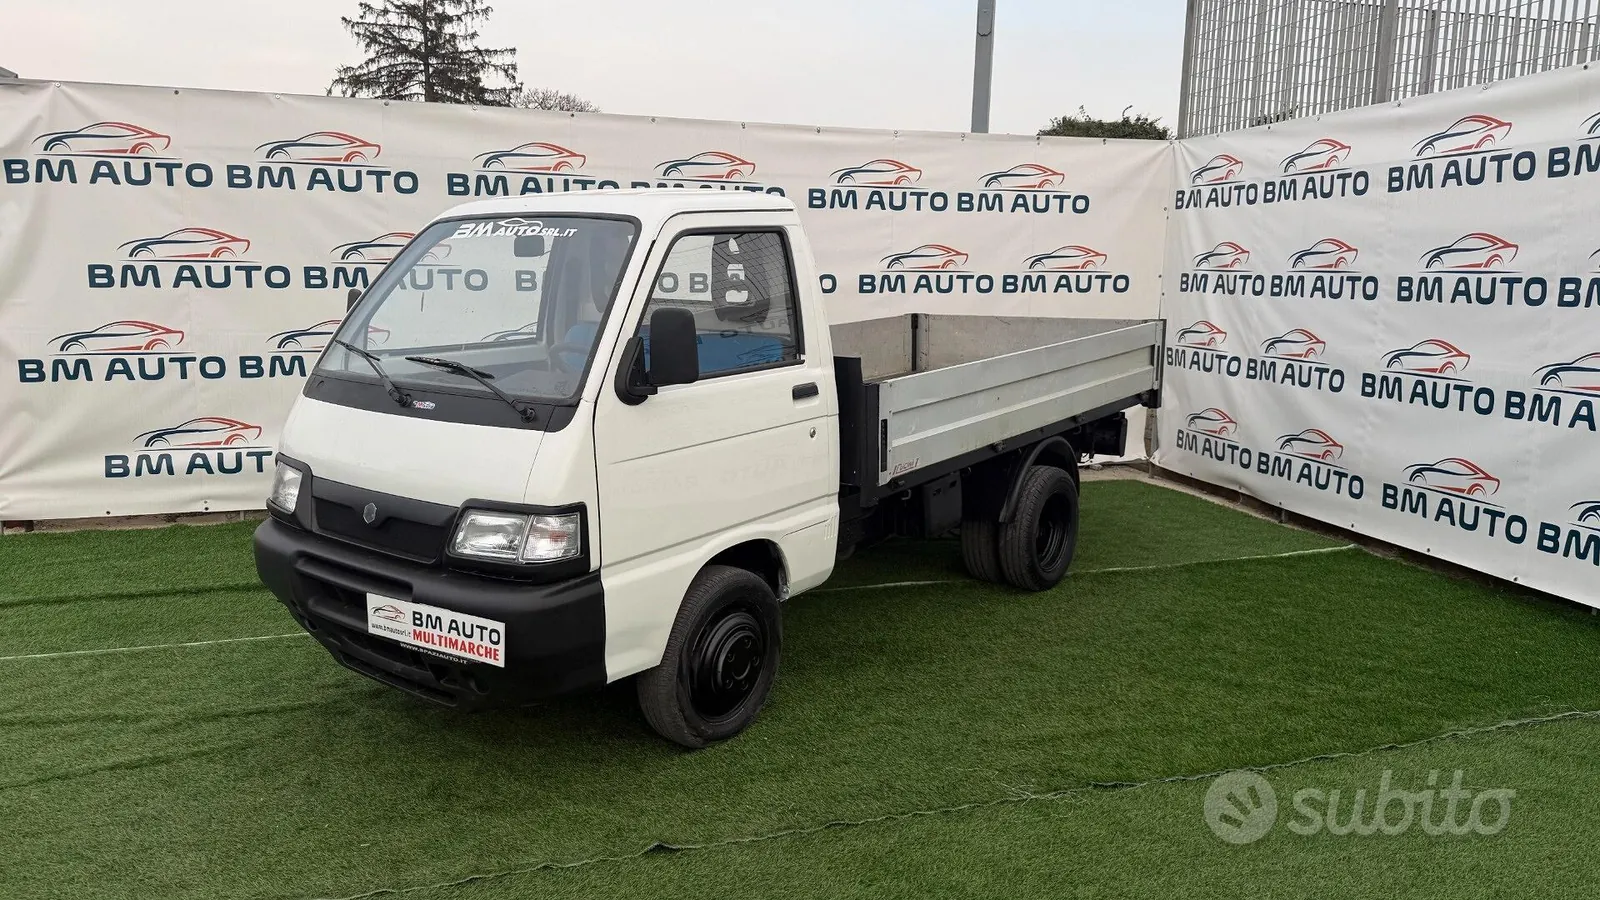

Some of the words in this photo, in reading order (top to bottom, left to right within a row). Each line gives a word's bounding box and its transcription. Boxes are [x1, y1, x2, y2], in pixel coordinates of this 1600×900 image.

[3, 158, 77, 184] BM
[89, 160, 214, 188] AUTO
[226, 164, 296, 190] BM
[306, 168, 419, 194] AUTO
[447, 173, 509, 197] BM
[1263, 179, 1297, 203] BM
[1302, 171, 1369, 200] AUTO
[1387, 159, 1434, 193] BM
[1440, 151, 1536, 188] AUTO
[808, 188, 857, 210] BM
[865, 190, 948, 212] AUTO
[957, 192, 1003, 213] BM
[1010, 194, 1090, 214] AUTO
[1175, 188, 1202, 209] BM
[1206, 182, 1258, 208] AUTO
[87, 263, 161, 289] BM
[172, 264, 291, 289] AUTO
[304, 266, 369, 289] BM
[858, 273, 906, 294] BM
[913, 274, 994, 294] AUTO
[1002, 274, 1049, 294] BM
[1053, 274, 1130, 294] AUTO
[1179, 272, 1208, 293] BM
[1212, 274, 1265, 297] AUTO
[1269, 274, 1305, 298] BM
[1310, 275, 1379, 300] AUTO
[1397, 275, 1443, 304] BM
[1451, 277, 1548, 307] AUTO
[18, 358, 93, 383] BM
[105, 356, 226, 381] AUTO
[239, 356, 306, 379] BM
[1166, 346, 1187, 369] BM
[1189, 351, 1241, 378] AUTO
[1246, 358, 1277, 383] BM
[1281, 363, 1345, 393] AUTO
[1361, 373, 1403, 402] BM
[1409, 380, 1495, 415] AUTO
[1504, 391, 1561, 426] BM
[1177, 429, 1198, 454] BM
[1202, 438, 1252, 469] AUTO
[104, 454, 175, 478] BM
[185, 451, 273, 475] AUT
[1257, 450, 1293, 481] BM
[1297, 464, 1364, 500] AUTO
[1382, 483, 1427, 518] BM
[1434, 499, 1527, 544] AUTO
[1537, 522, 1600, 566] BM
[412, 610, 443, 632] BM
[447, 618, 501, 646] AUTO
[412, 629, 500, 661] MULTIMARCHE
